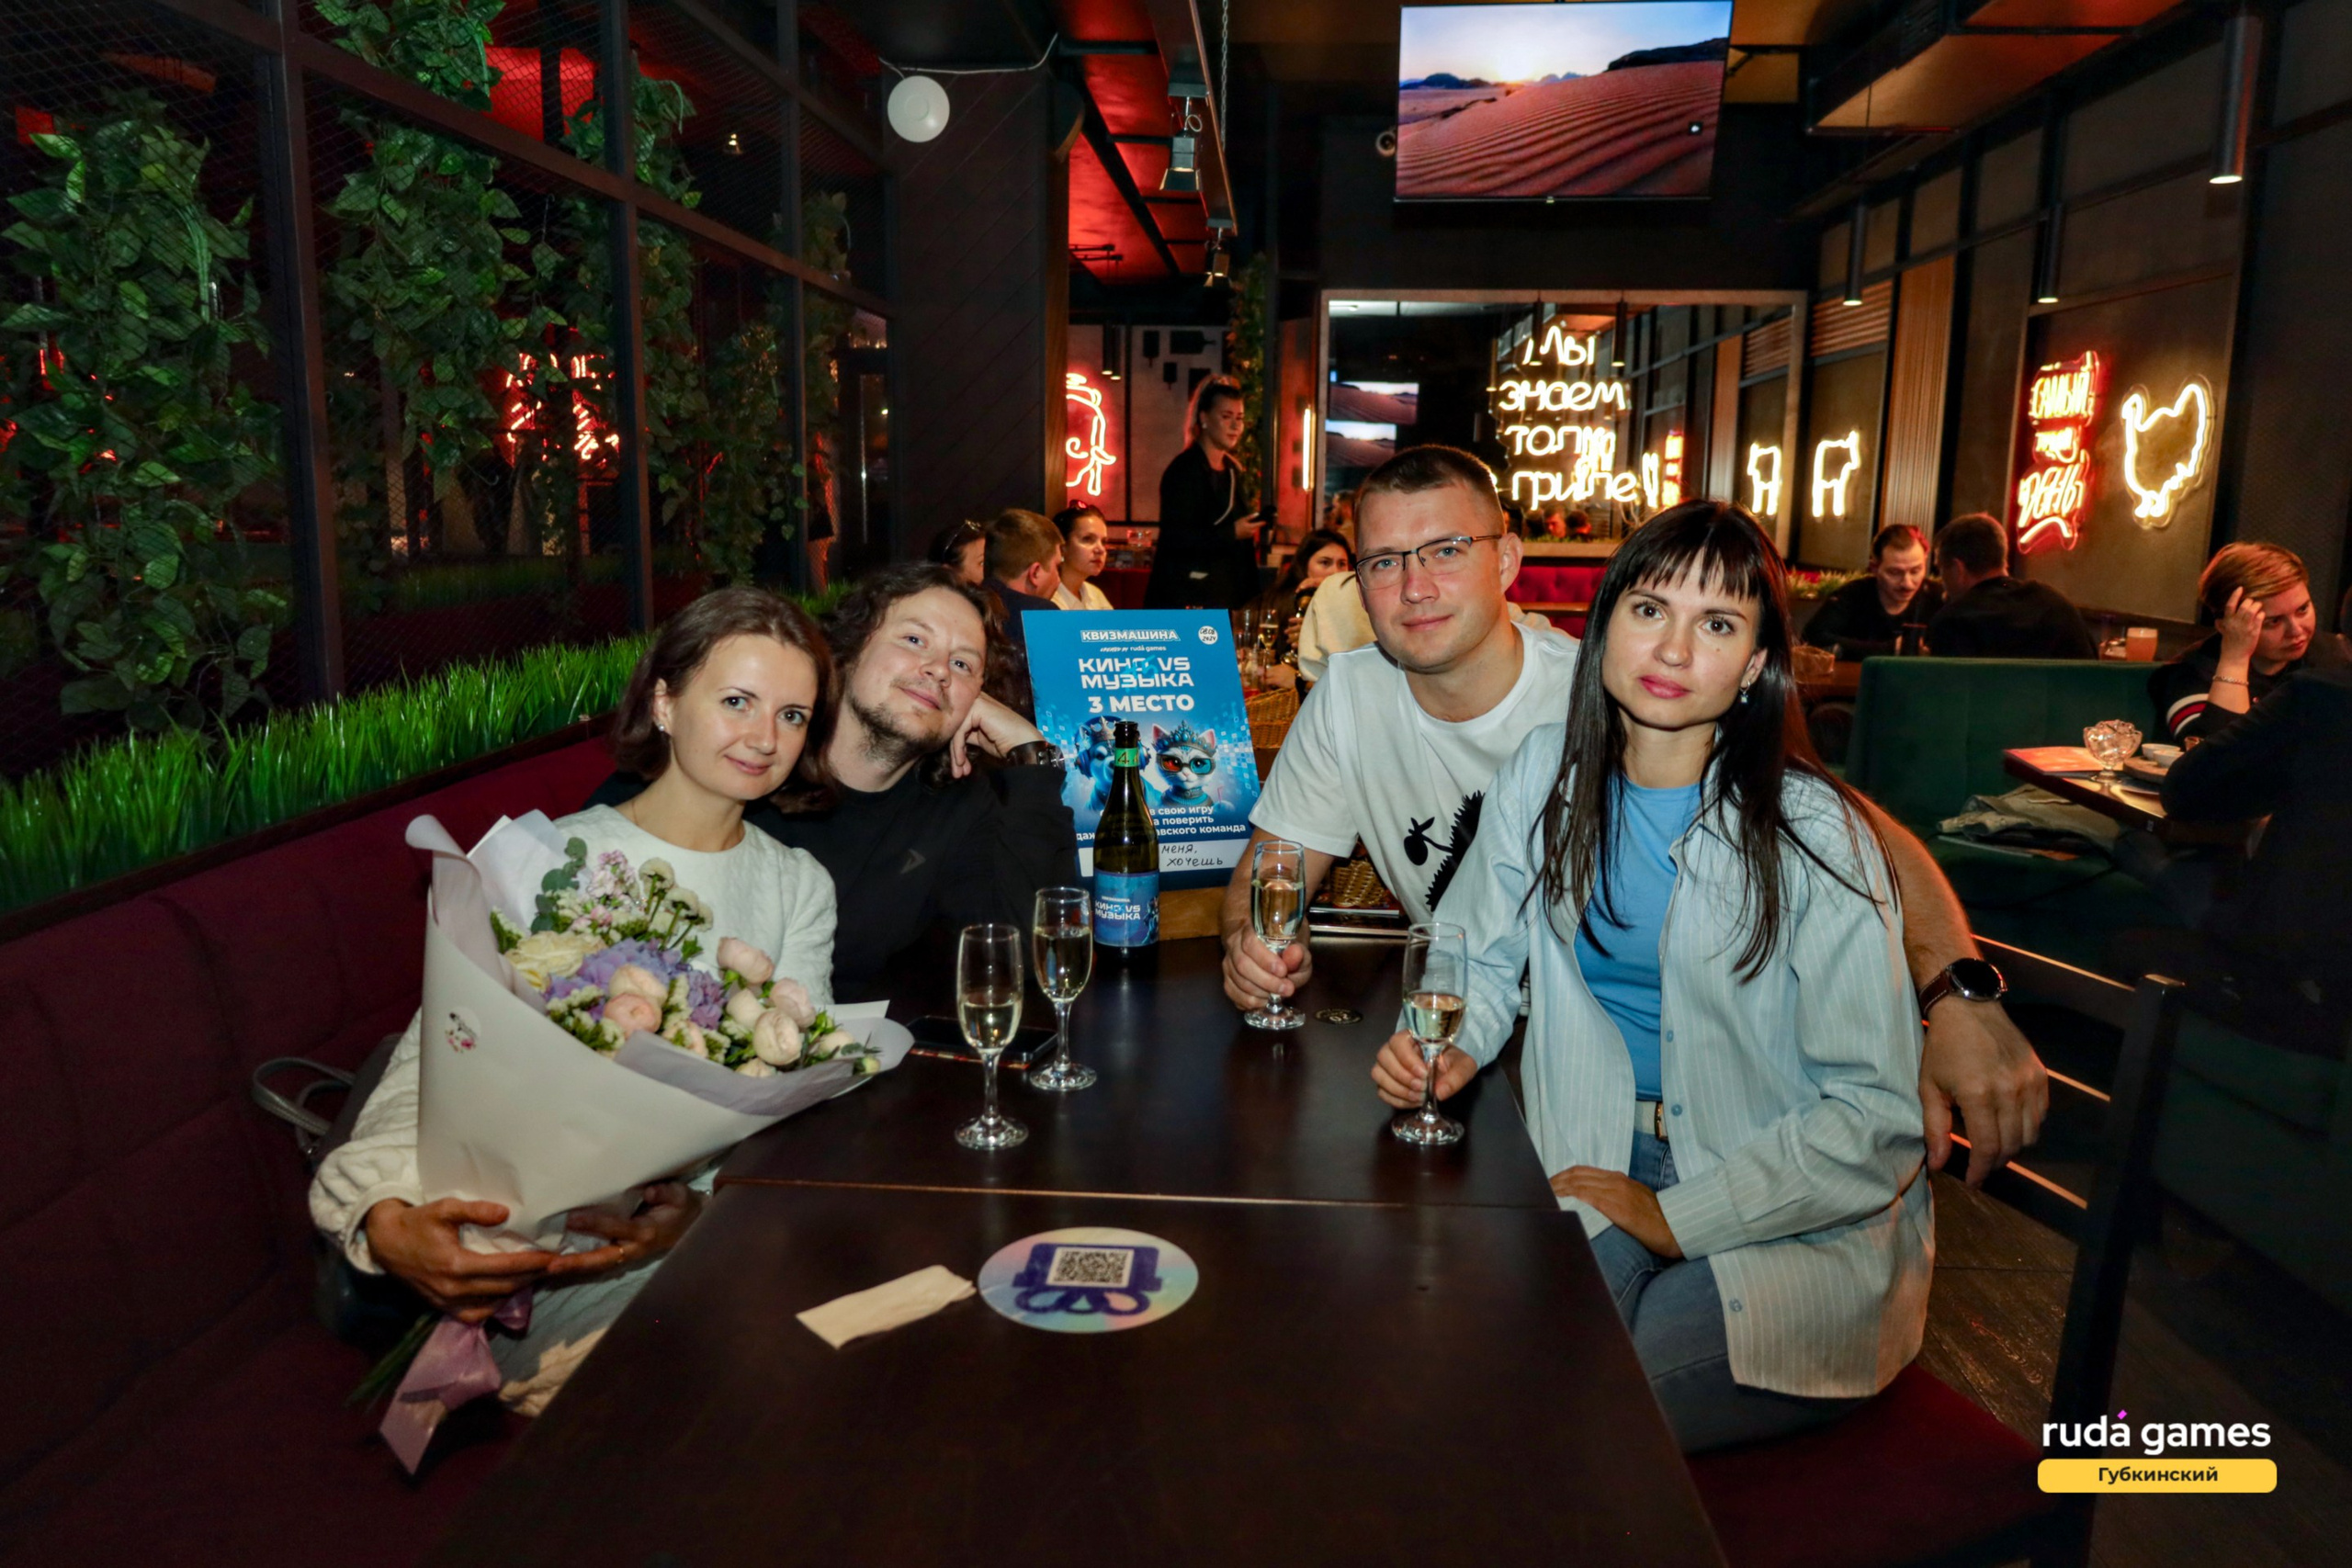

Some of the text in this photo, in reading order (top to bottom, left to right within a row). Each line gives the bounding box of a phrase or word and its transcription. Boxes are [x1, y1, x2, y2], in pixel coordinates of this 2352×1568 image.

[1521, 325, 1597, 366] Мы
[1498, 379, 1628, 412] знаем
[1081, 629, 1179, 641] КВИЗМАШИНА
[1146, 645, 1167, 653] games
[1078, 657, 1191, 672] КИНО VS
[1080, 672, 1194, 690] МУЗЫКА
[1087, 694, 1195, 714] 3 МЕСТО
[1158, 807, 1187, 816] свою
[1188, 806, 1214, 816] игру
[1161, 816, 1215, 827] поверить
[1199, 824, 1247, 835] команда
[1166, 856, 1224, 868] хочешь
[1095, 900, 1141, 913] КИНО VS
[1095, 908, 1141, 920] МУЗЫКА
